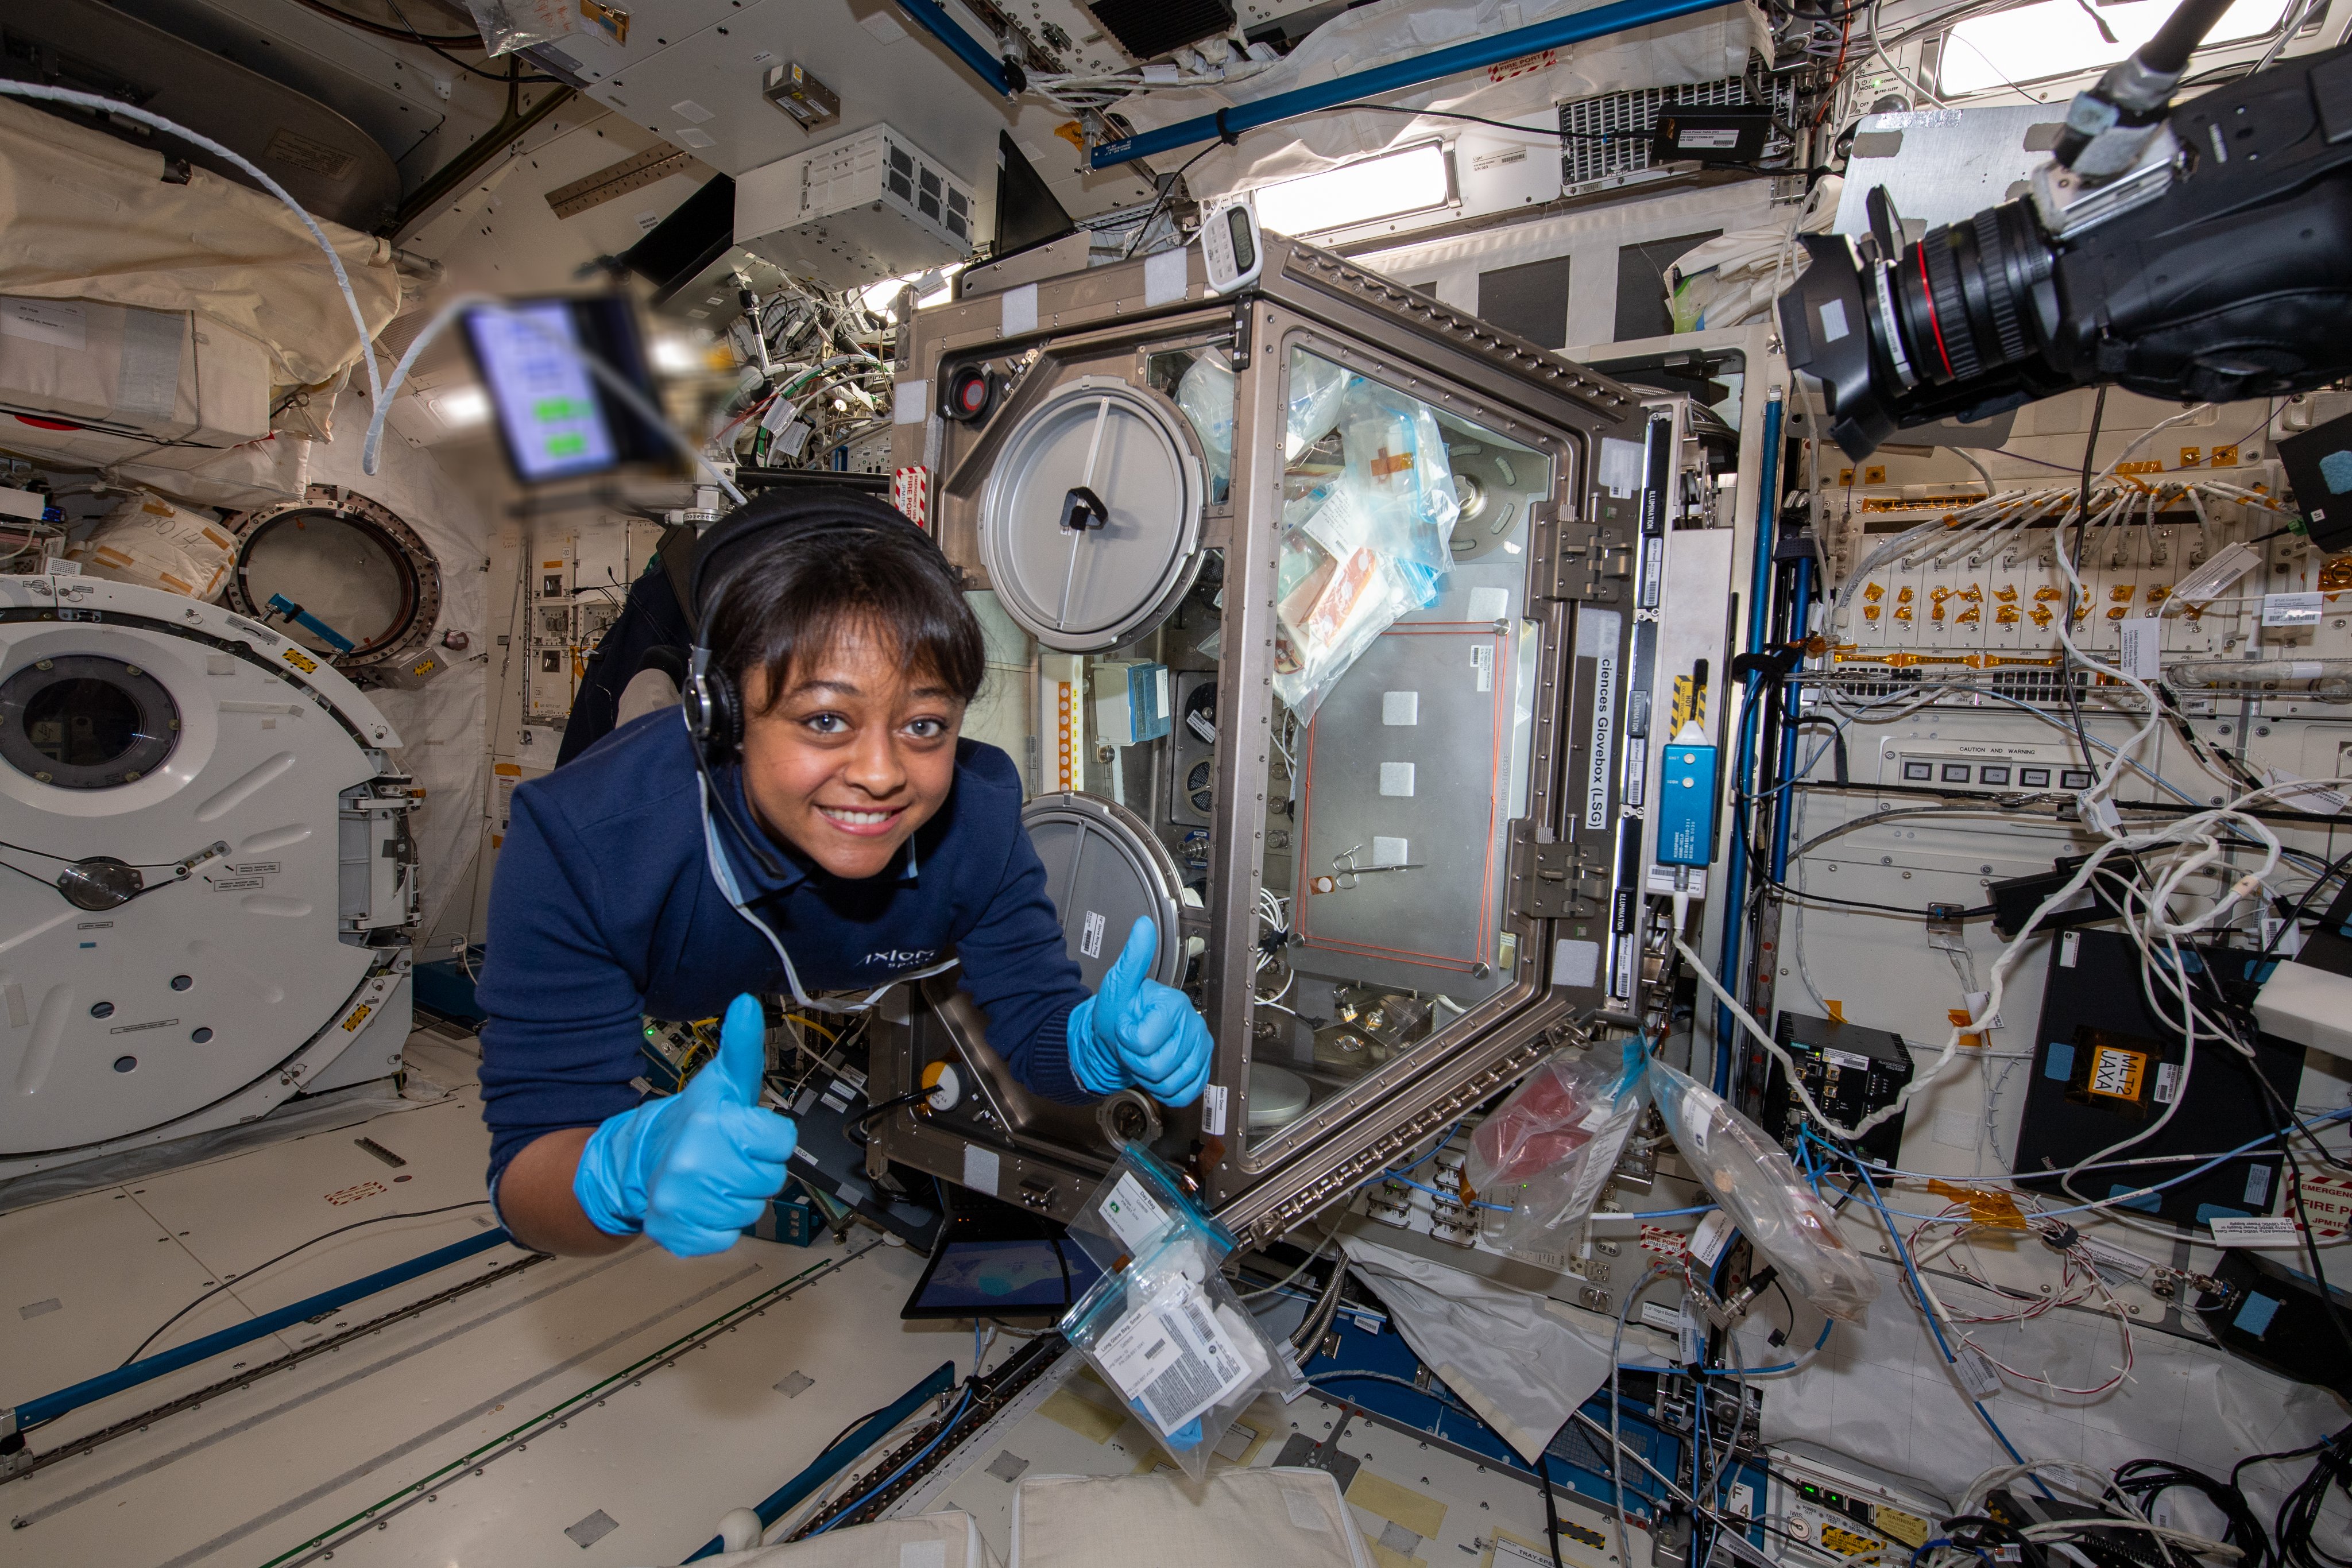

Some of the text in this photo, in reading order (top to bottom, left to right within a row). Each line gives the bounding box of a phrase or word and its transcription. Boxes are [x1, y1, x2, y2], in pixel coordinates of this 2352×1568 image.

[1500, 55, 1541, 71] FIRE PORT
[1647, 490, 1656, 529] ILLUMINATION
[1632, 694, 1641, 732] ILLUMINATION
[1588, 659, 1612, 827] ciences Glovebox (LSG)
[1616, 893, 1626, 931] ILLUMINATION
[1878, 1060, 1906, 1069] RUGGEDCOM
[2095, 1050, 2117, 1089] JAXA
[2116, 1054, 2139, 1095] MLT2
[797, 1149, 807, 1157] ELC4
[1139, 1191, 1148, 1201] Day
[2301, 1184, 2352, 1199] EMERGENC
[2301, 1199, 2335, 1213] FIRE
[1647, 1230, 1670, 1239] EMERGENCY
[1647, 1235, 1680, 1247] FIRE PORT
[2096, 1249, 2111, 1259] Ethernet
[1100, 1313, 1142, 1352] Long Glove Bag, Small
[1732, 1486, 1743, 1499] F
[1739, 1504, 1749, 1517] 4
[1789, 1510, 1803, 1519] IWIS
[1802, 1505, 1817, 1513] POWER
[1886, 1513, 1917, 1528] WARNING
[1848, 1526, 1864, 1535] SELECT
[1835, 1532, 1860, 1544] CAUTION
